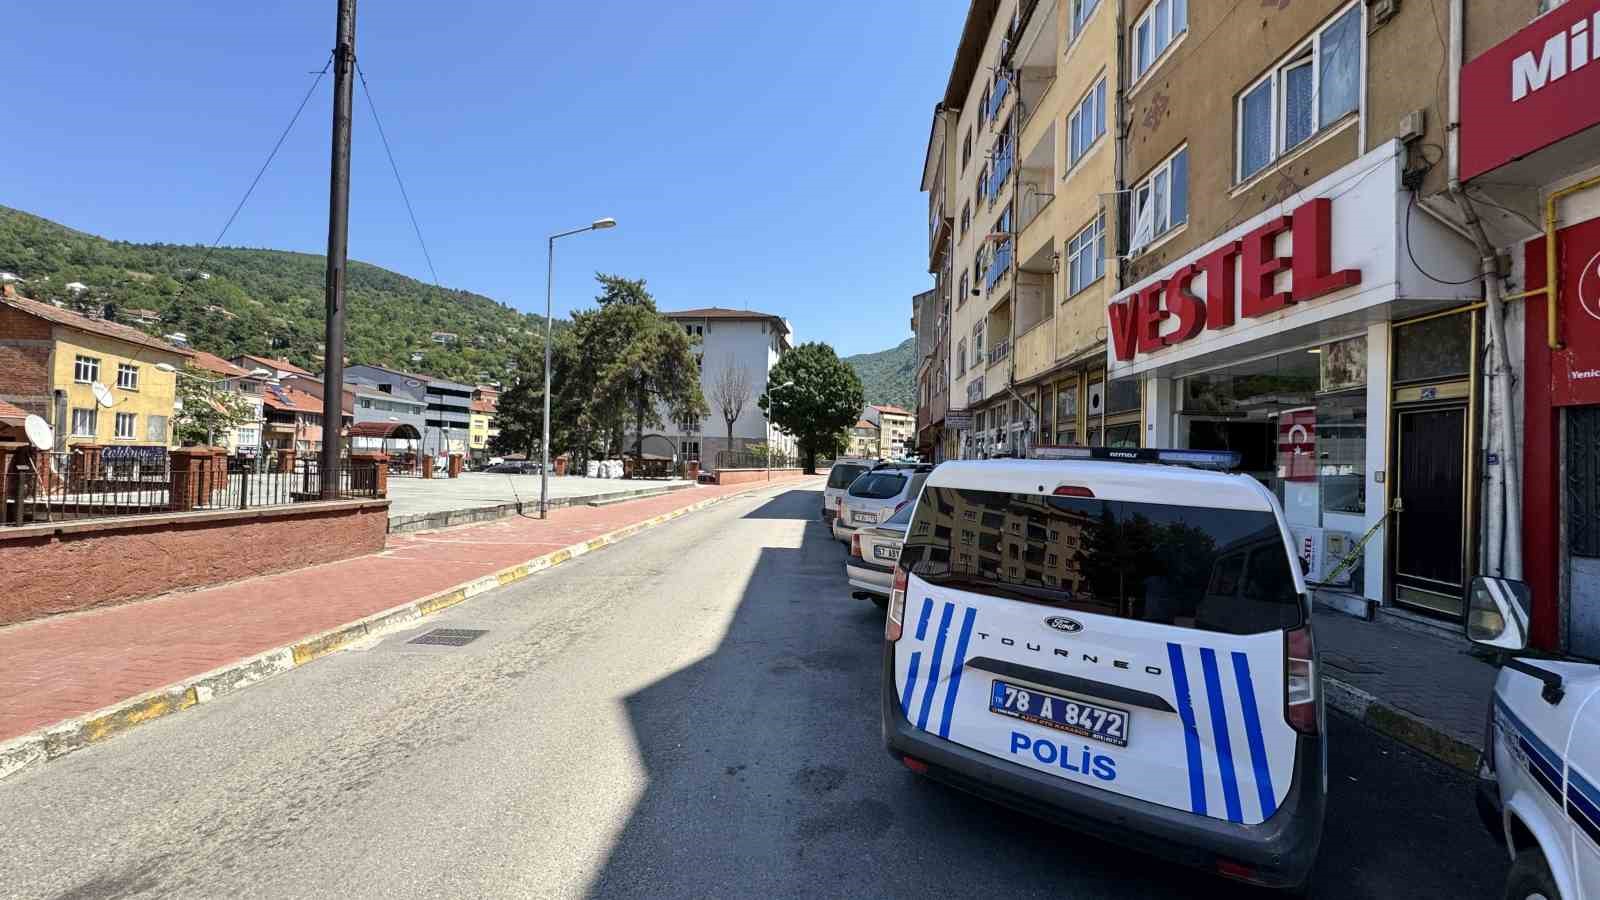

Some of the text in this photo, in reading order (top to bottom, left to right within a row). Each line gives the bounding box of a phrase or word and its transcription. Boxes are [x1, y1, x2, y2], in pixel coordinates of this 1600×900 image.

[1109, 198, 1361, 361] VESTEL
[978, 632, 1162, 676] TOURNEO
[1005, 686, 1030, 712] 78
[1040, 697, 1053, 720] A
[1065, 703, 1122, 737] 8472
